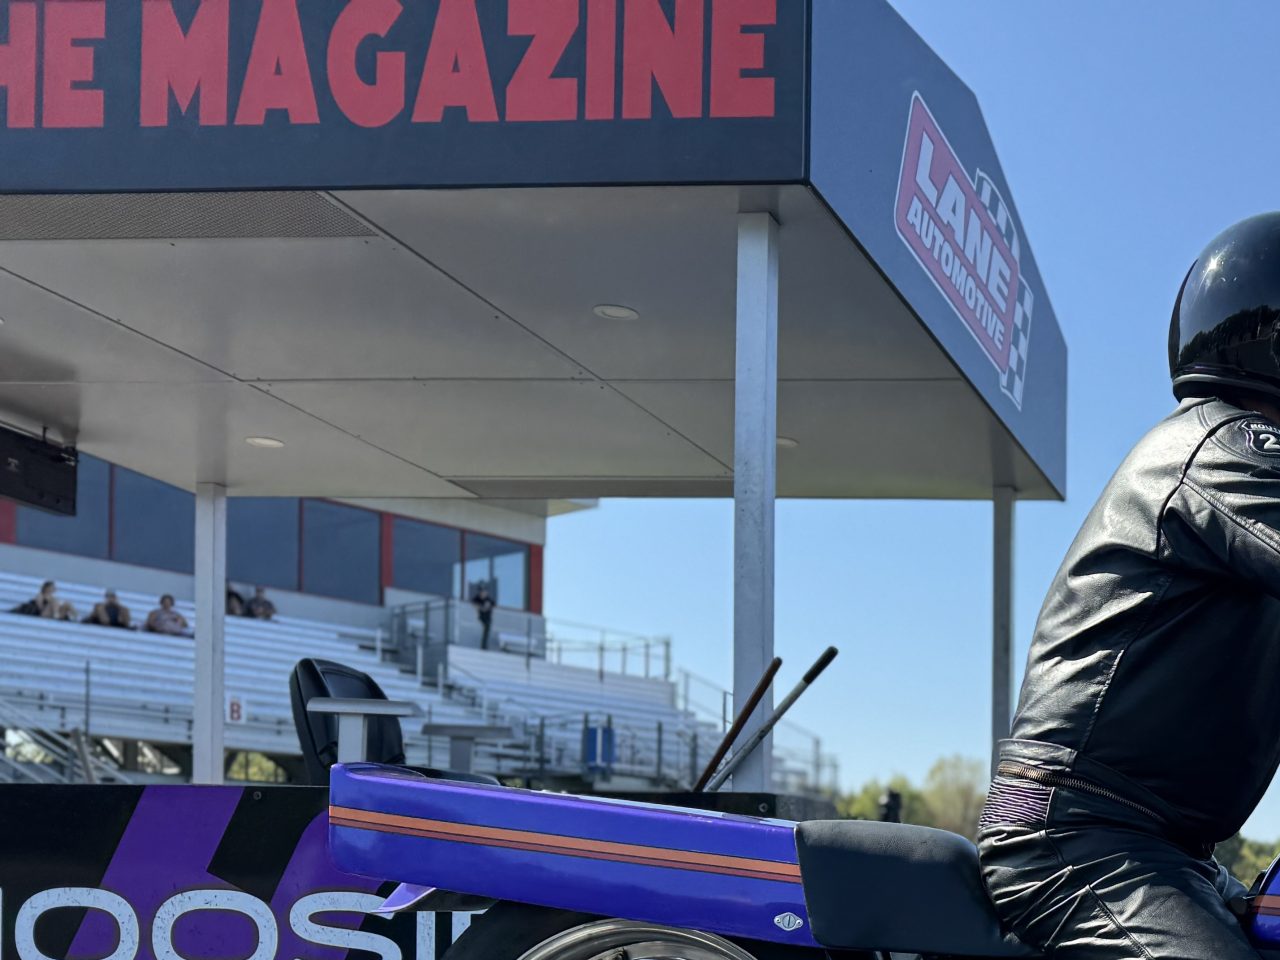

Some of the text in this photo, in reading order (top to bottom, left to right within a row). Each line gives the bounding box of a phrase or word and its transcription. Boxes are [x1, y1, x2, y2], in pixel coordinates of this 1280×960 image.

[139, 0, 777, 128] MAGAZINE
[906, 196, 1005, 352] AUTOMOTIVE
[915, 130, 1013, 314] LANE
[230, 701, 242, 721] B
